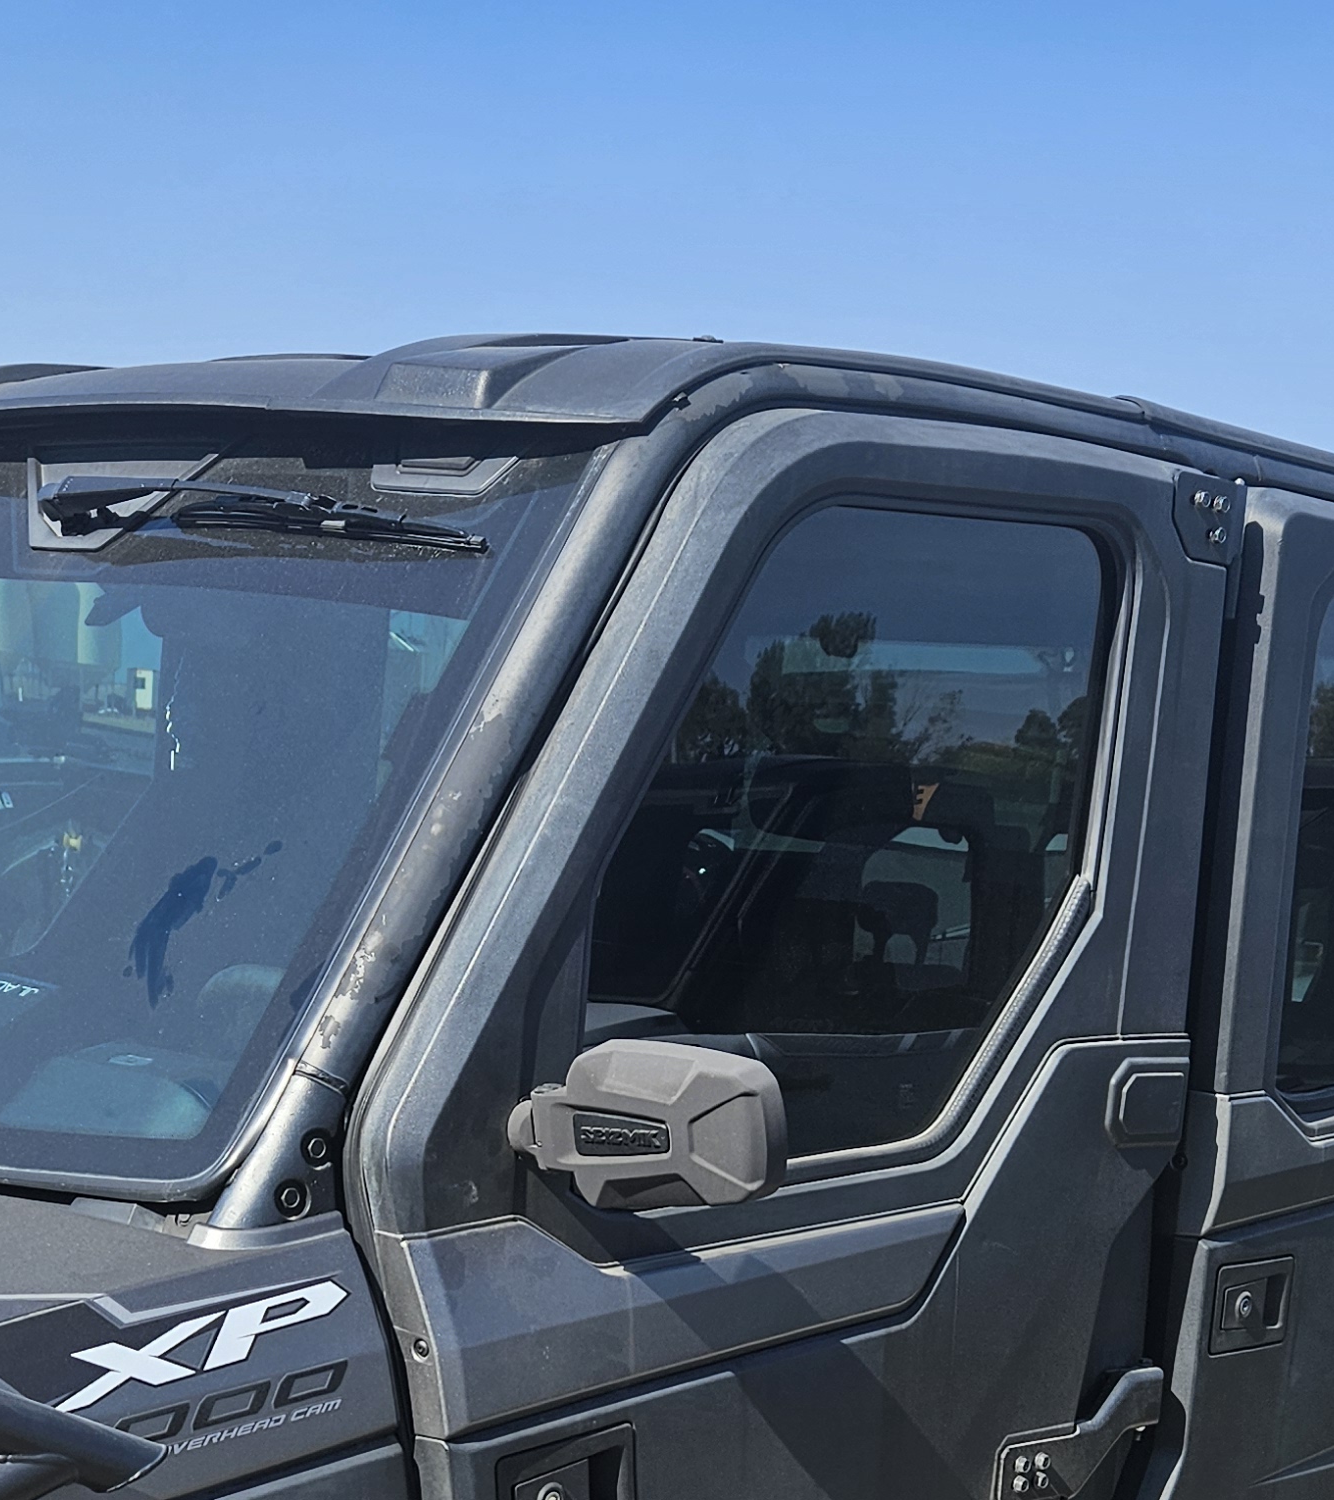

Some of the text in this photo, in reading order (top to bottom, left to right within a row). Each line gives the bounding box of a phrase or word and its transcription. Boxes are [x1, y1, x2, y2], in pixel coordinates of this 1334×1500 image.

[580, 1125, 662, 1149] SEIZMIK
[54, 1279, 350, 1413] XP
[290, 1398, 343, 1422] CAM
